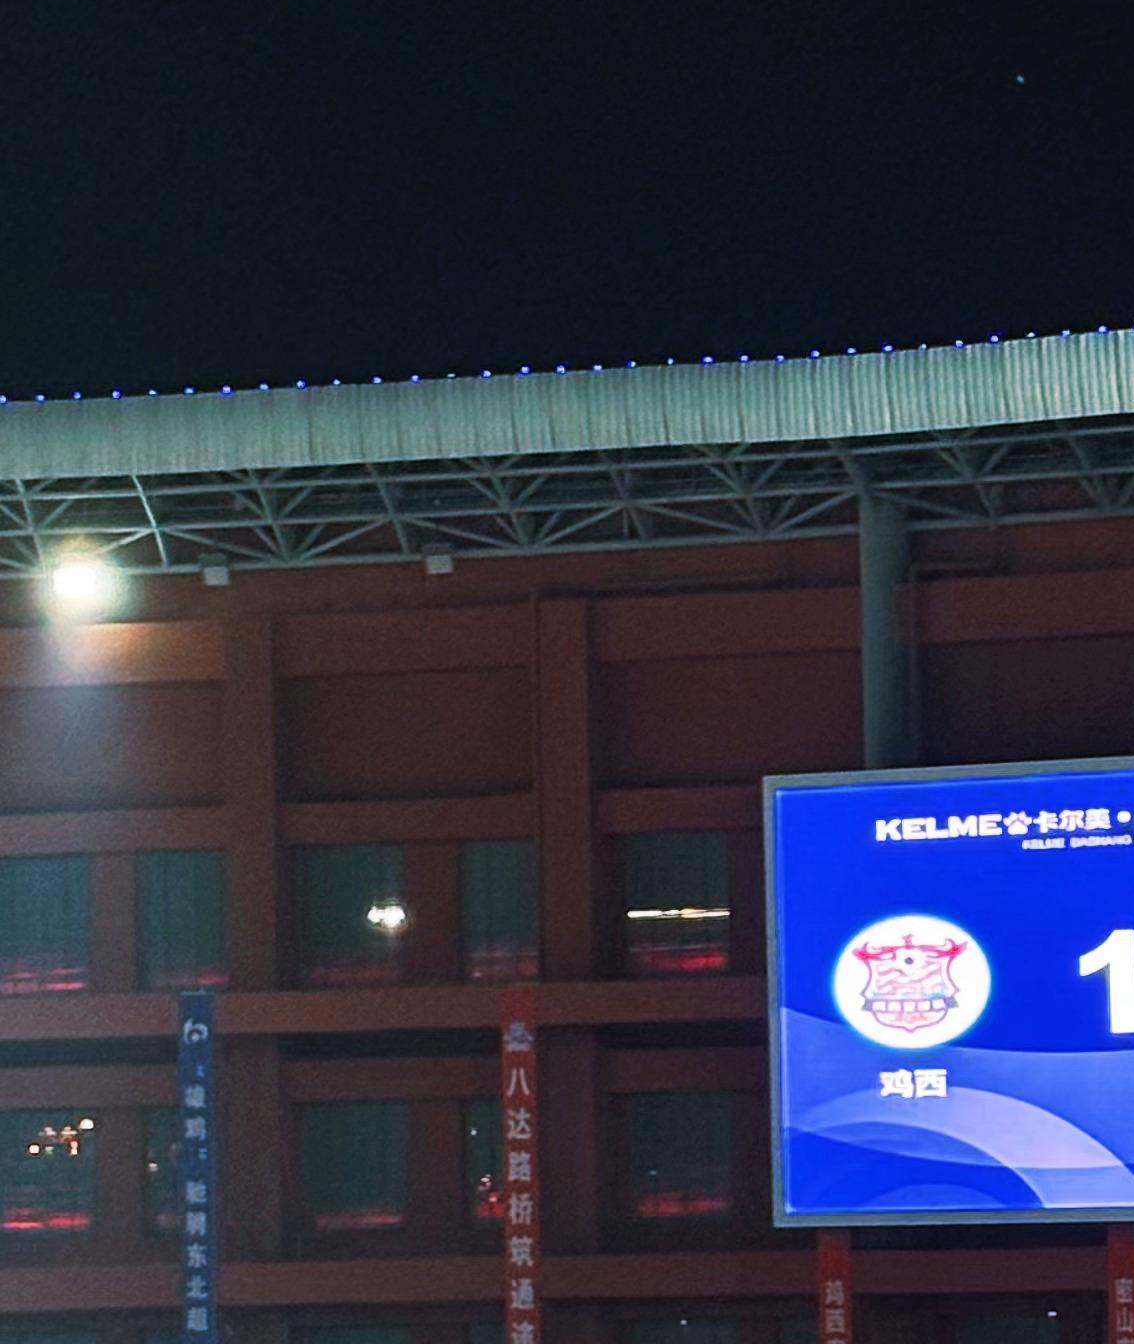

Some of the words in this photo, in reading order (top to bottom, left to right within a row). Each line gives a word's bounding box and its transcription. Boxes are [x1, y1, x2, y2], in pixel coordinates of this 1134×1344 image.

[875, 813, 1003, 841] KELME
[1033, 808, 1112, 833] 卡尔美
[880, 1069, 948, 1098] 鸡西
